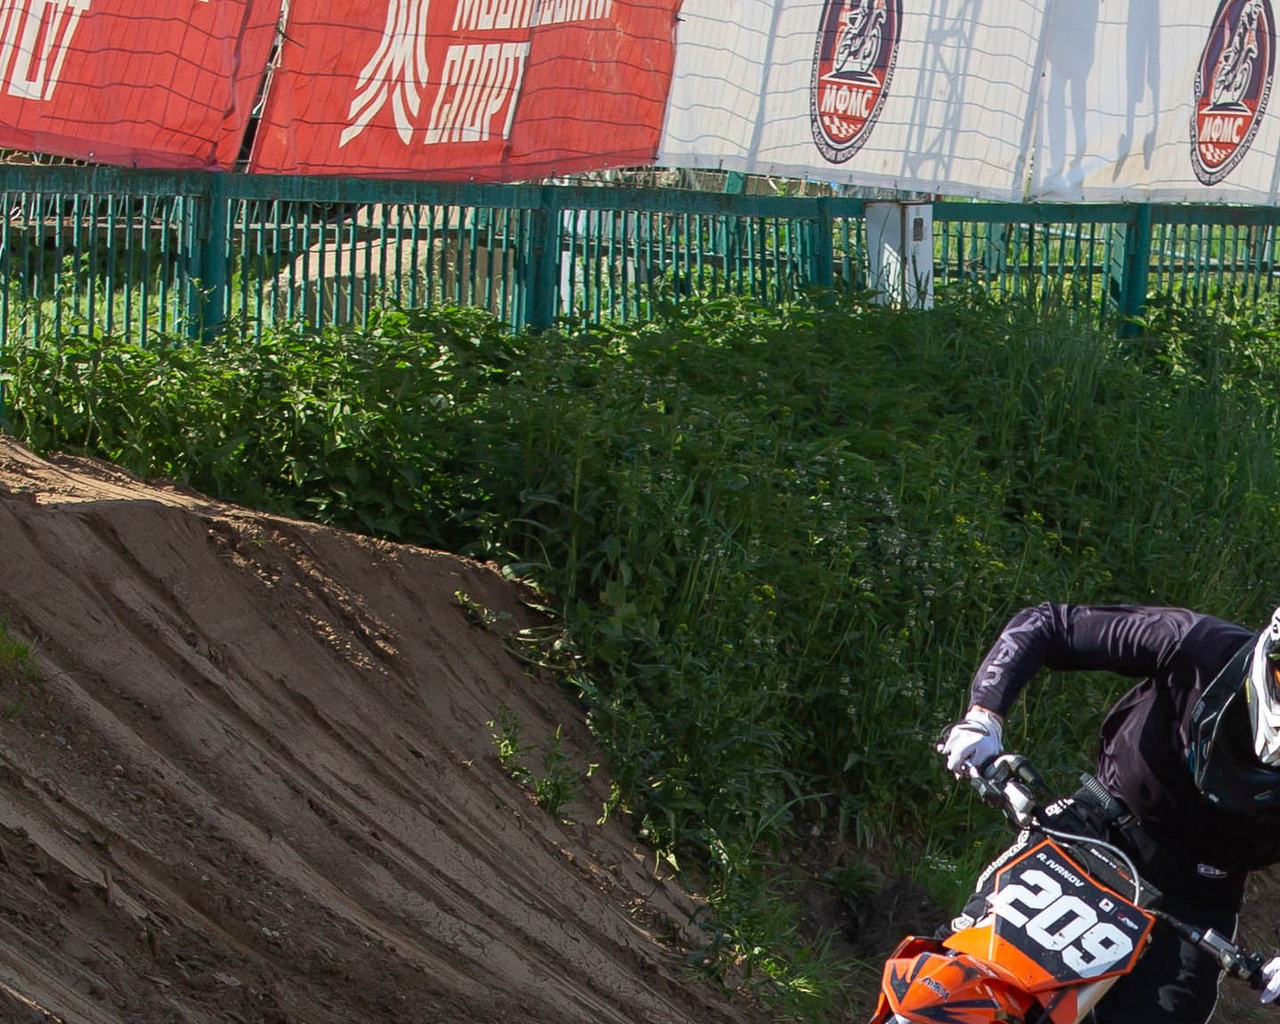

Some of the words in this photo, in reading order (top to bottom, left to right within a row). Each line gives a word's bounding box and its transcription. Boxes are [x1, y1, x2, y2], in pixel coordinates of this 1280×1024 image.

[424, 41, 531, 145] СПОРТ
[820, 83, 874, 119] МФМС
[1200, 116, 1244, 144] МФМС
[985, 869, 1134, 979] 209
